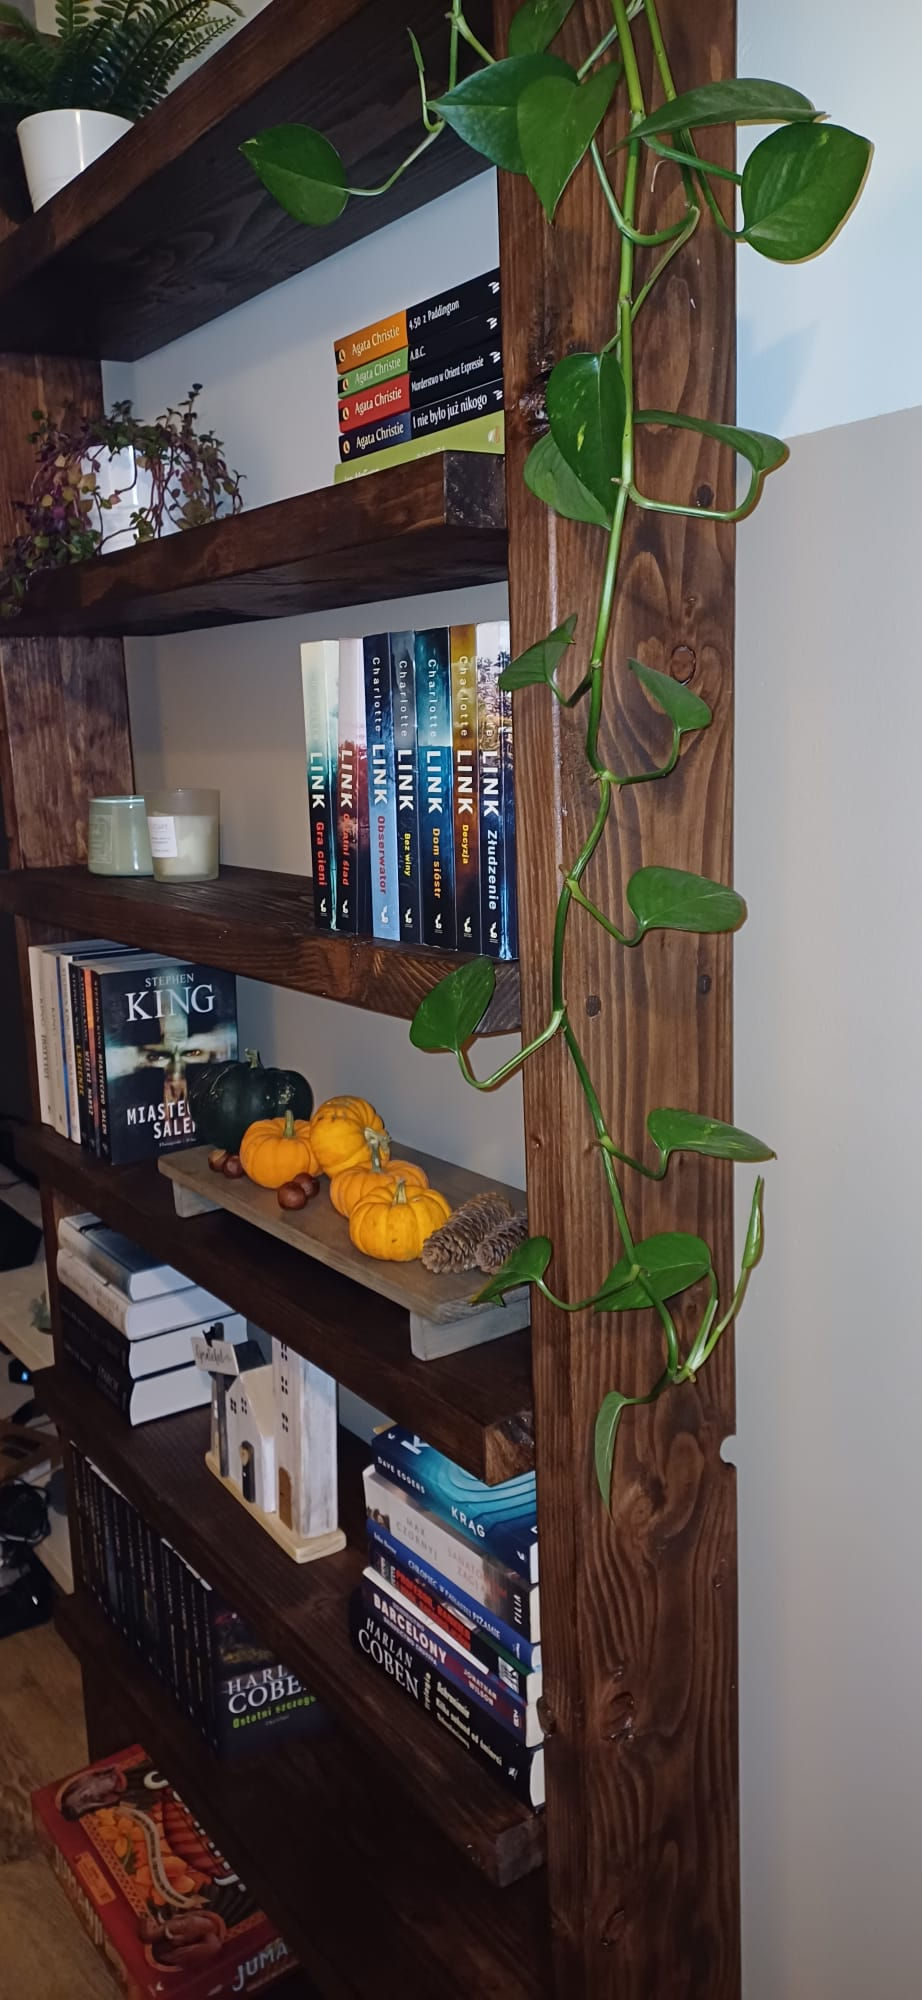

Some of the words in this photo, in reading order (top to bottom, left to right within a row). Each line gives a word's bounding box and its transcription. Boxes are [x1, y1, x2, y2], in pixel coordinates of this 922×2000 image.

[409, 316, 422, 331] 4.50
[427, 300, 460, 321] Paddington
[351, 338, 372, 357] Agata
[371, 324, 400, 347] Christie
[410, 345, 426, 362] A.B.C.
[354, 369, 374, 386] Agata
[373, 356, 401, 377] Christie
[444, 364, 460, 381] Orient
[460, 355, 485, 377] Expressie
[354, 399, 374, 416] Agata
[374, 387, 402, 408] Christie
[412, 415, 417, 429] I
[417, 412, 429, 426] nie
[429, 406, 446, 425] było
[447, 402, 459, 421] już
[460, 393, 488, 413] nikogo
[356, 432, 376, 449] Agata
[376, 422, 404, 441] Christie
[372, 656, 382, 733] Charlotte
[398, 659, 408, 738] Charlotte
[427, 658, 437, 738] Charlotte
[458, 655, 468, 737] Charlotte
[310, 752, 326, 809] LINK
[340, 750, 353, 809] LINK
[372, 744, 388, 806] LINK
[397, 749, 414, 811] LINK
[426, 750, 443, 814] LINK
[457, 750, 474, 815] LINK
[482, 750, 500, 817] LINK
[316, 821, 325, 846] Gra
[432, 827, 441, 856] Dom
[461, 824, 469, 865] Decyzja
[317, 850, 328, 887] cieni
[377, 815, 387, 895] Obserwator
[403, 854, 411, 878] winy
[487, 829, 498, 911] Złudzenie
[433, 860, 442, 900] sióstr
[145, 972, 195, 988] STEPHEN
[125, 983, 216, 1022] KING
[377, 1456, 396, 1474] DAVE
[396, 1469, 426, 1495] EGGERS
[451, 1505, 486, 1538] KRĄG
[373, 1592, 447, 1665] BARCELONY
[513, 1594, 522, 1625] FILIA
[366, 1618, 413, 1669] HARLAN
[358, 1628, 419, 1700] COBEN
[228, 1675, 306, 1714] COBE
[232, 1706, 272, 1729] Ostatni
